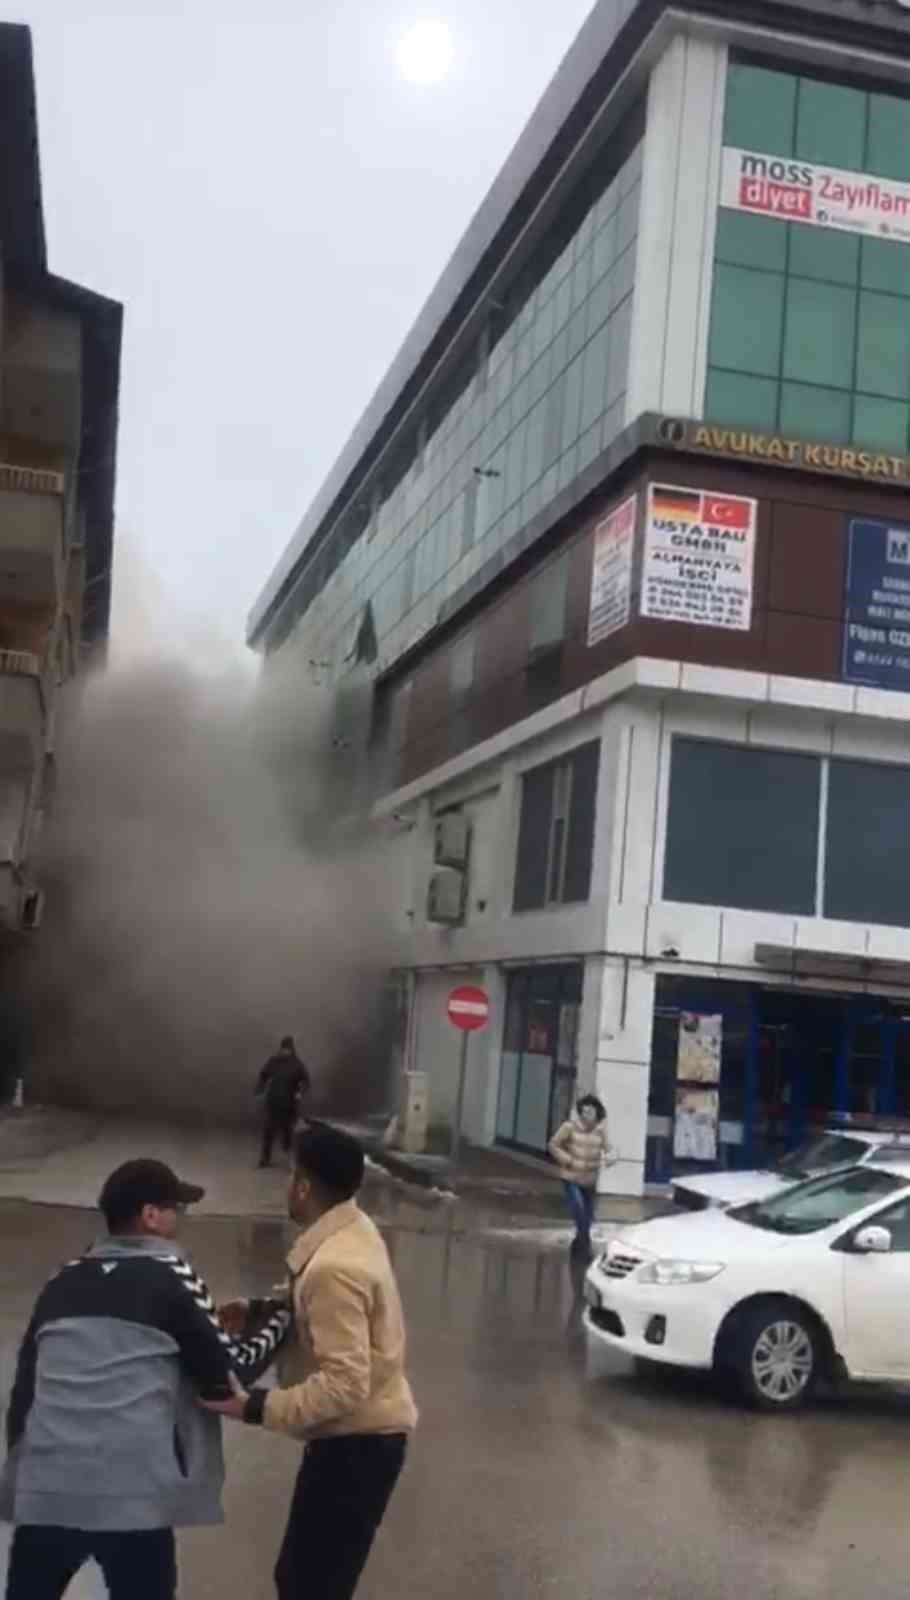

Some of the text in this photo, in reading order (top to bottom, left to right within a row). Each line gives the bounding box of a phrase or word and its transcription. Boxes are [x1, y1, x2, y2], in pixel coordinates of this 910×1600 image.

[741, 155, 813, 187] moss
[695, 428, 797, 460] AVUKAT
[653, 519, 703, 537] USTA
